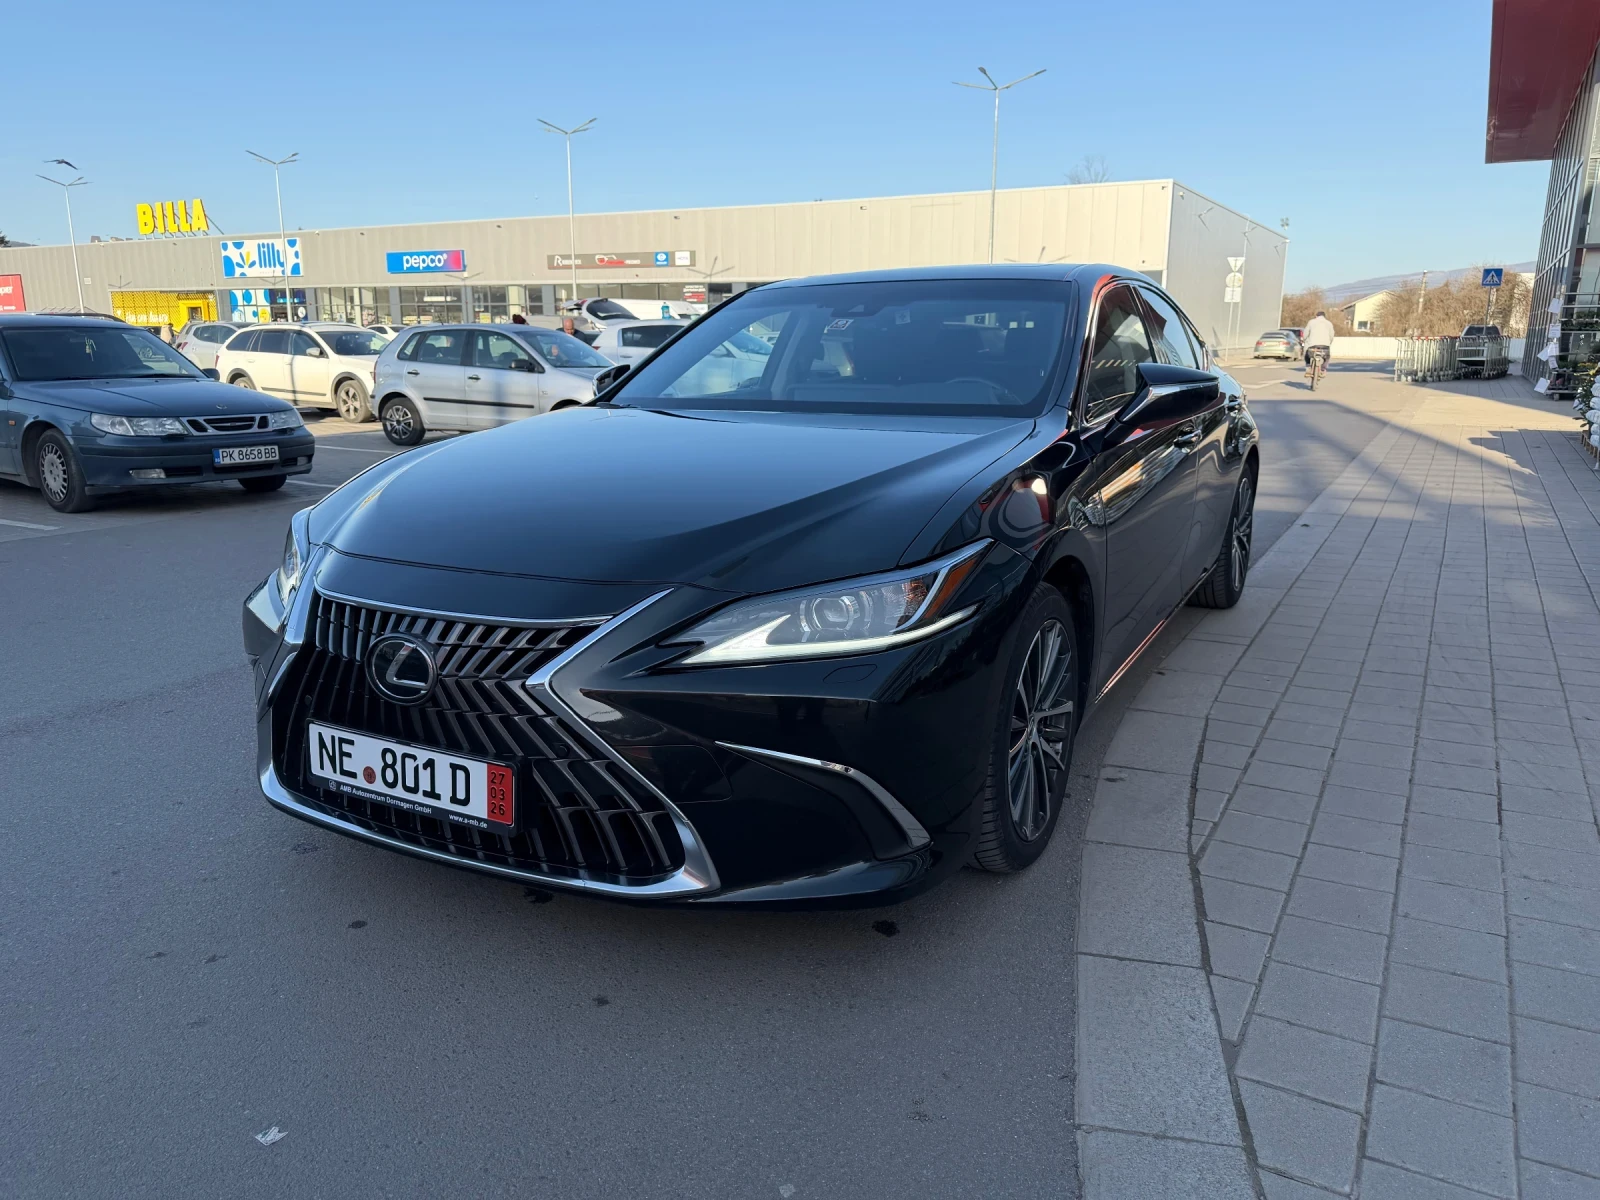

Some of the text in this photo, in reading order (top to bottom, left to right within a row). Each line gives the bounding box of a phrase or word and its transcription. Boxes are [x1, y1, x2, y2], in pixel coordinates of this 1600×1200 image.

[136, 198, 209, 235] BILLA
[257, 242, 286, 276] lilly
[403, 254, 444, 270] pepco
[221, 450, 236, 462] PK
[238, 448, 263, 461] 8658
[264, 447, 277, 459] BB
[318, 731, 471, 807] NE 801 D
[490, 771, 506, 785] 27
[339, 783, 432, 815] AMB Autozentrum Dormagen GmbH
[490, 786, 506, 801] 03
[490, 801, 506, 816] 26
[449, 813, 488, 829] www.a-mb.de
